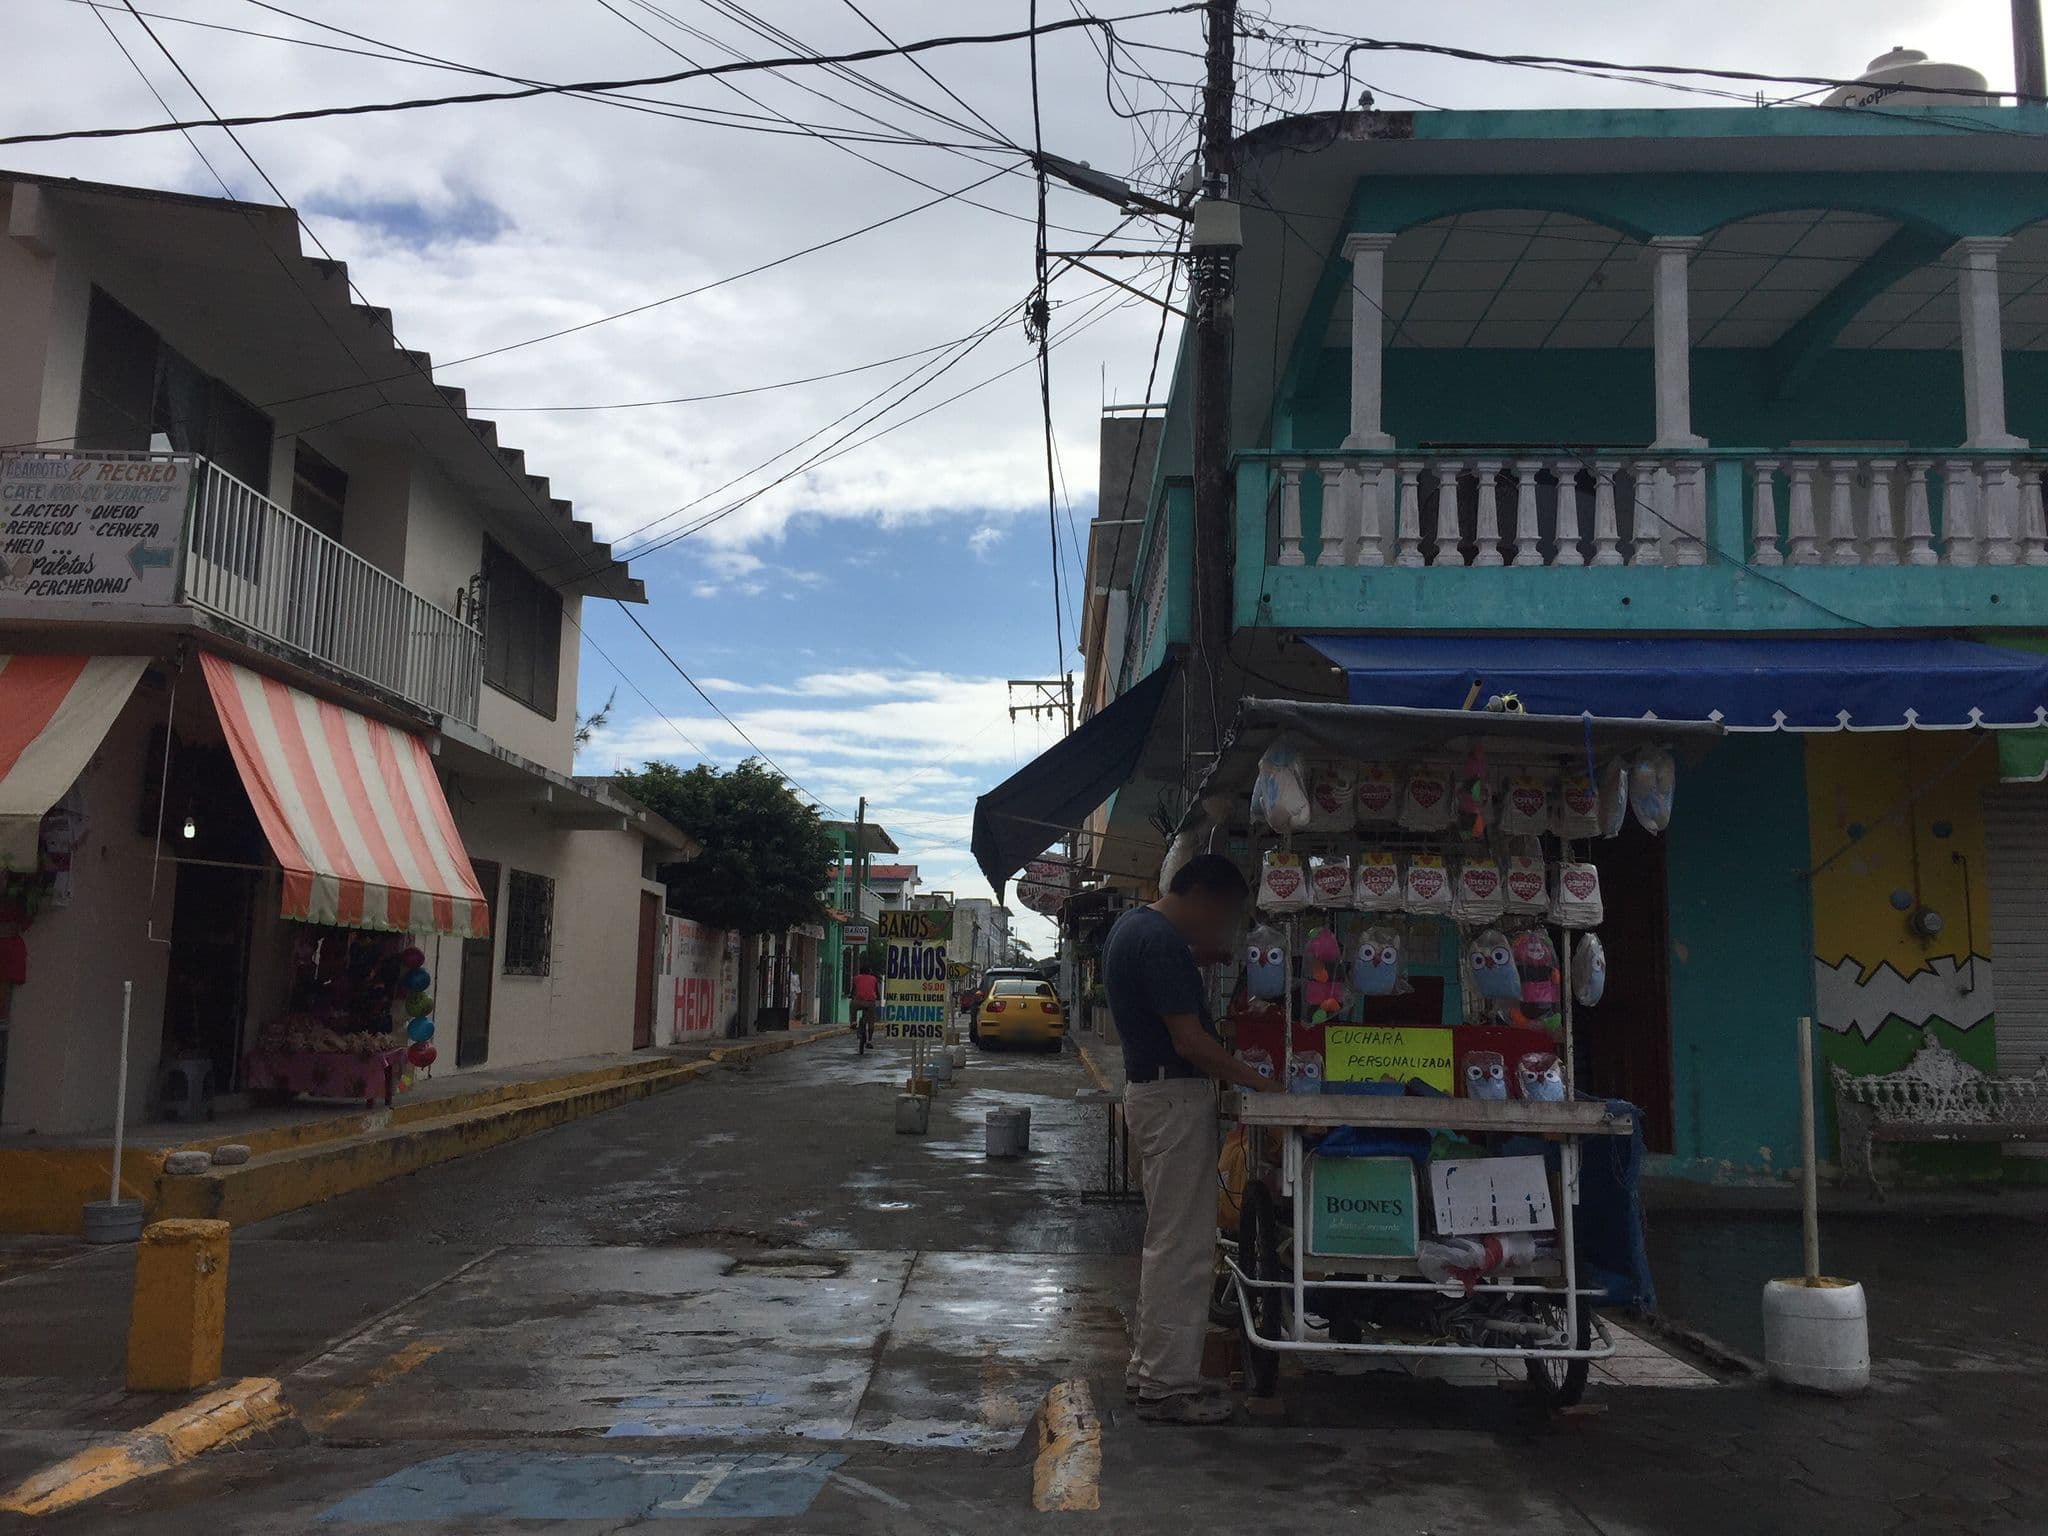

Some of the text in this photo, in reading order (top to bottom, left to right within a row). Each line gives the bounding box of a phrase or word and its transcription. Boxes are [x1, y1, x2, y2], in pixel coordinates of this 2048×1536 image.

[97, 464, 177, 482] RECREO
[10, 504, 144, 520] LACTEOS QUESOS
[5, 521, 160, 538] REFRESCOS CERVEZA
[5, 538, 45, 554] HIELO
[29, 553, 95, 576] Paletas
[24, 577, 132, 596] PERCHERONAS
[879, 912, 928, 938] BAÑOS
[888, 941, 946, 980] BAÑOS
[922, 982, 945, 991] $5.00
[674, 976, 714, 1032] HEIDI
[900, 993, 921, 1002] HOTEL
[923, 993, 944, 1002] LUCIA
[885, 1024, 943, 1039] 15 PASOS
[1331, 1030, 1404, 1045] CUCHARA
[1347, 1054, 1451, 1068] PERSONALIZADA
